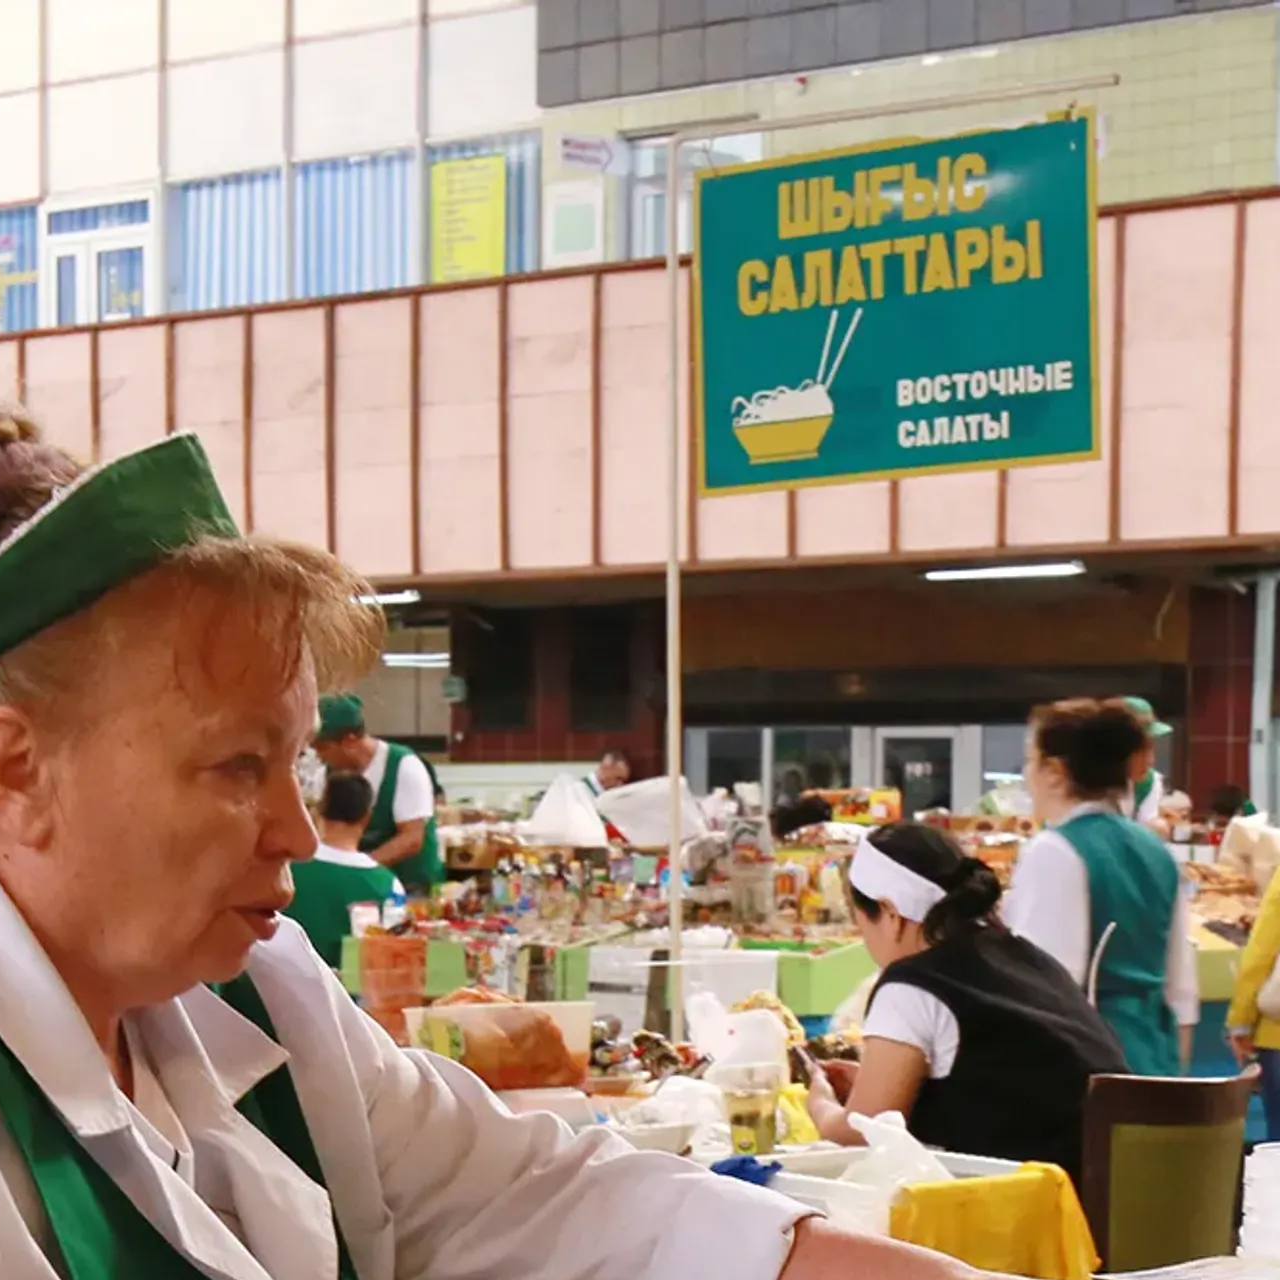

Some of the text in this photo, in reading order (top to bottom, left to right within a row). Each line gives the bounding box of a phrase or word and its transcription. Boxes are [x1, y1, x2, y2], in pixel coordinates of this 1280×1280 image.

[736, 219, 1044, 317] САЛАТТАРЫ
[896, 361, 1074, 407] ВОСТОЧНЫЕ
[897, 411, 1010, 448] САЛАТЫ
